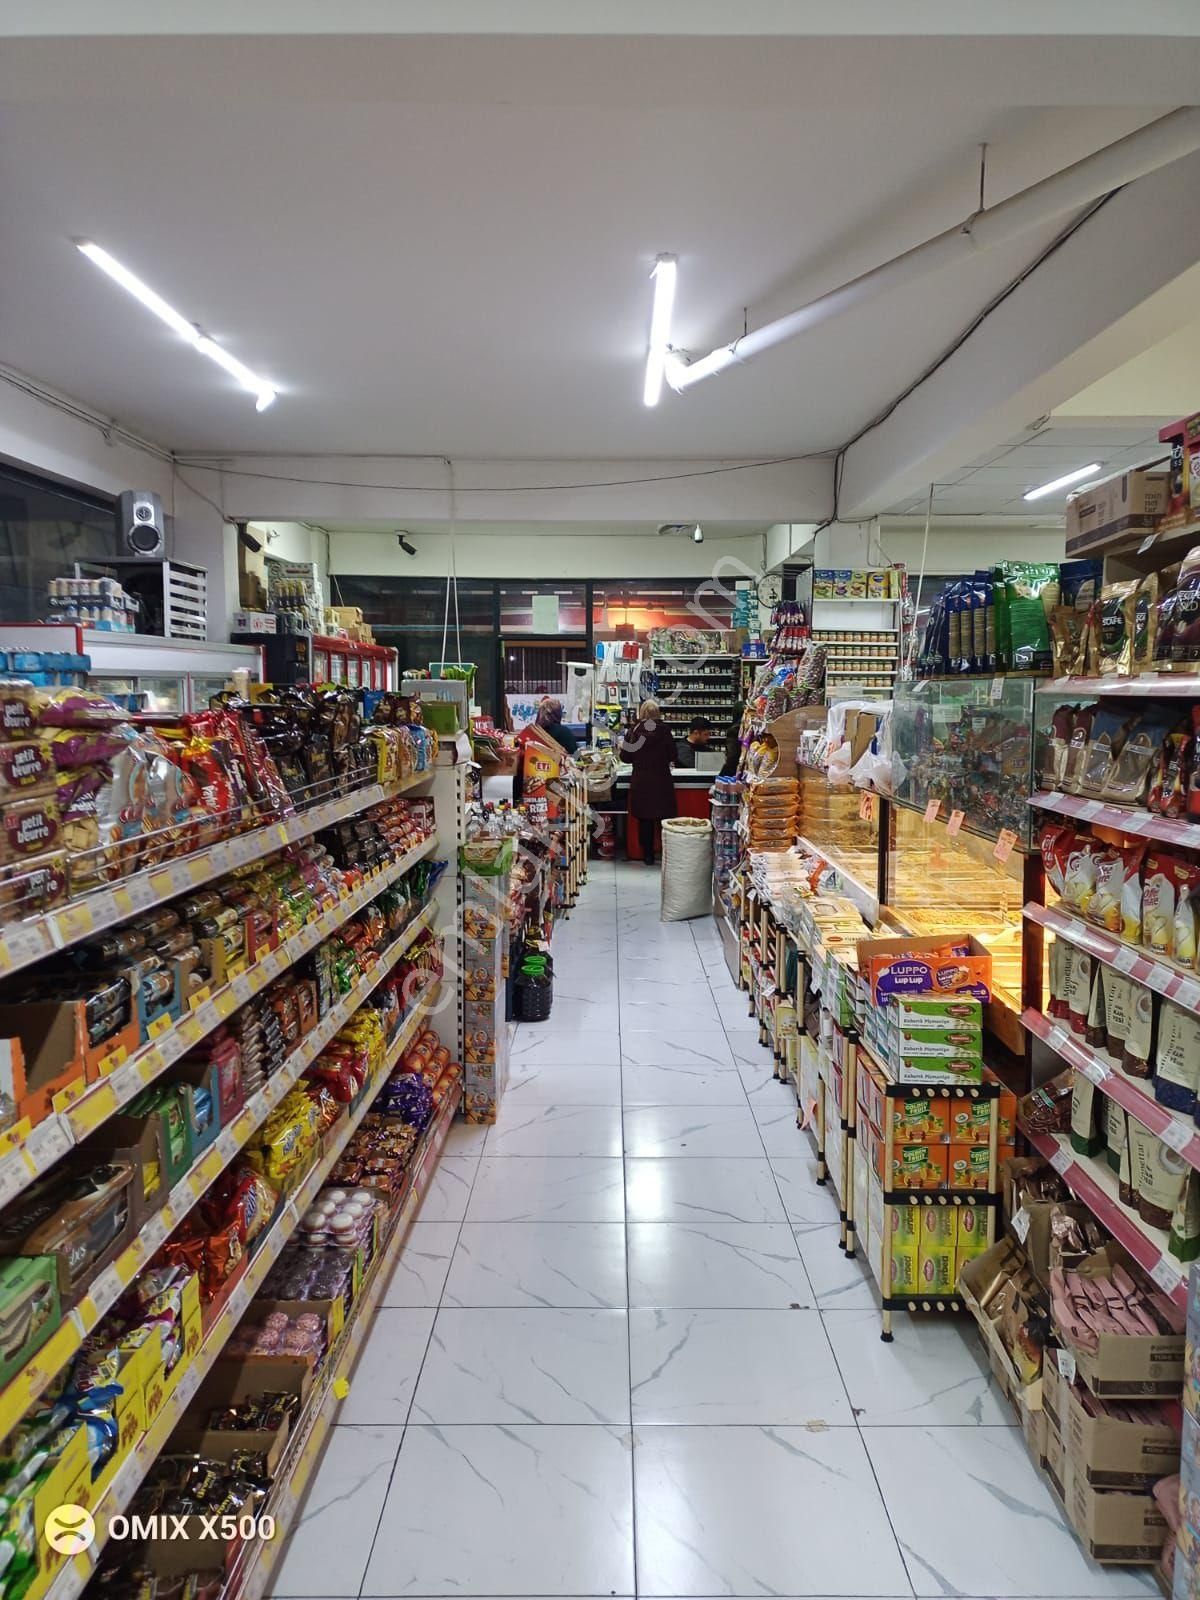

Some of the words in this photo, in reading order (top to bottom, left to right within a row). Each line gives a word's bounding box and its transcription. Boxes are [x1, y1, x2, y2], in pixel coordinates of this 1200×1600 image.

[14, 748, 35, 765] petit
[11, 760, 42, 778] beurre
[21, 813, 43, 832] petit
[17, 824, 49, 844] beurre
[890, 966, 928, 975] LUPPO
[894, 976, 909, 985] Lup
[909, 976, 923, 985] Lup
